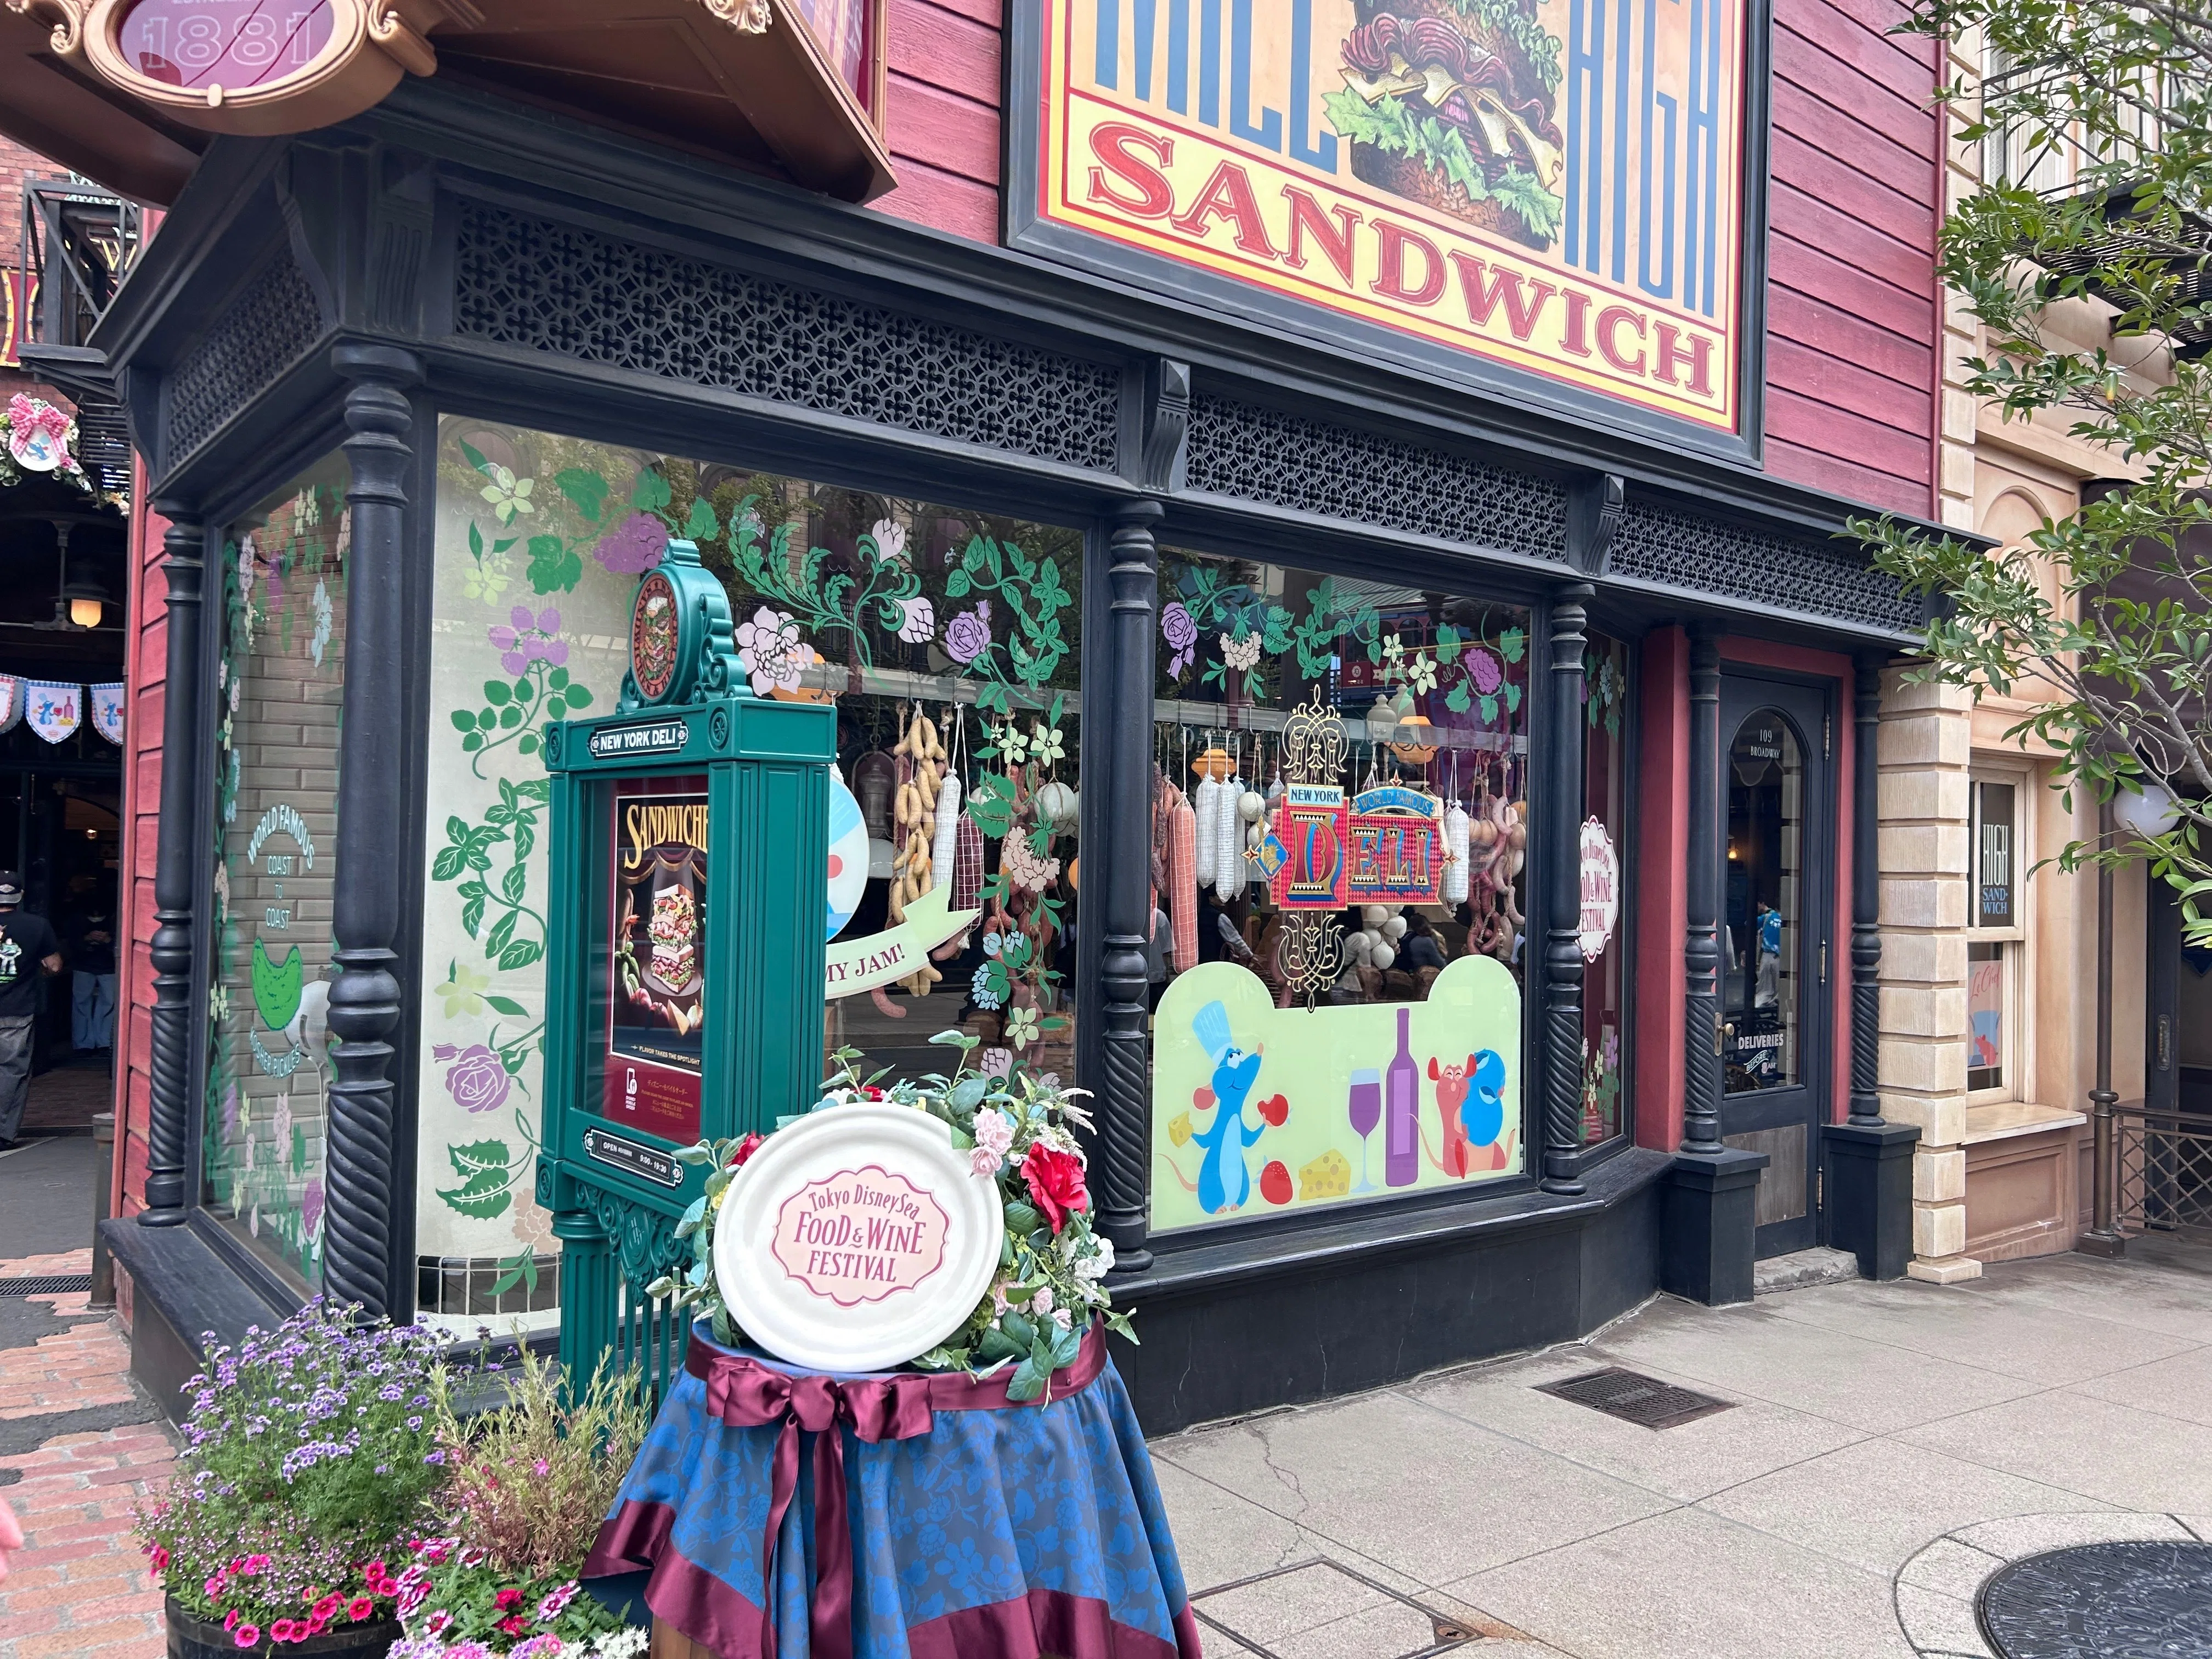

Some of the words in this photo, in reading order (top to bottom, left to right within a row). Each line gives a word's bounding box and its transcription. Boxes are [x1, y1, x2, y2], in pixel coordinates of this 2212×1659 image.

[142, 12, 311, 68] 1881
[1087, 121, 1714, 399] SANDWICH
[601, 734, 622, 751] NEW
[624, 731, 650, 748] YORK
[652, 728, 676, 746] DELI
[1760, 729, 1772, 742] 109
[1750, 746, 1780, 759] BROADWAY
[1291, 789, 1312, 802] NEW
[1314, 790, 1340, 803] YORK
[1360, 791, 1393, 810] WORLD
[1395, 791, 1430, 813] FAMOUS
[247, 806, 278, 866] WORLD
[280, 804, 315, 870] FAMOUS
[268, 855, 292, 875] COAST
[1287, 811, 1433, 901] DELI
[1983, 824, 2008, 886] HIGH
[275, 884, 283, 899] TO
[1581, 871, 1589, 902] OD
[1594, 871, 1611, 902] WINE
[266, 907, 290, 930] COAST
[1983, 902, 2007, 915] WICH
[1581, 909, 1605, 932] ESTIVAL
[826, 962, 849, 982] MY
[855, 943, 905, 977] JAM!
[250, 1026, 271, 1074] KOSHER
[274, 1043, 300, 1077] PICKLES
[1738, 1033, 1784, 1050] DELIVERIES
[639, 1046, 654, 1054] FLAVOR
[655, 1049, 668, 1058] TAKES
[677, 1054, 701, 1065] SPOTLIGHT
[1746, 1052, 1767, 1072] BEFORE
[603, 1142, 617, 1152] OPEN
[809, 1188, 849, 1211] Tokyo
[854, 1184, 920, 1220] DisneySea
[793, 1211, 851, 1246] FOOD
[848, 1227, 864, 1248] &
[868, 1217, 926, 1254] WINE
[807, 1250, 896, 1282] FESTIVAL
